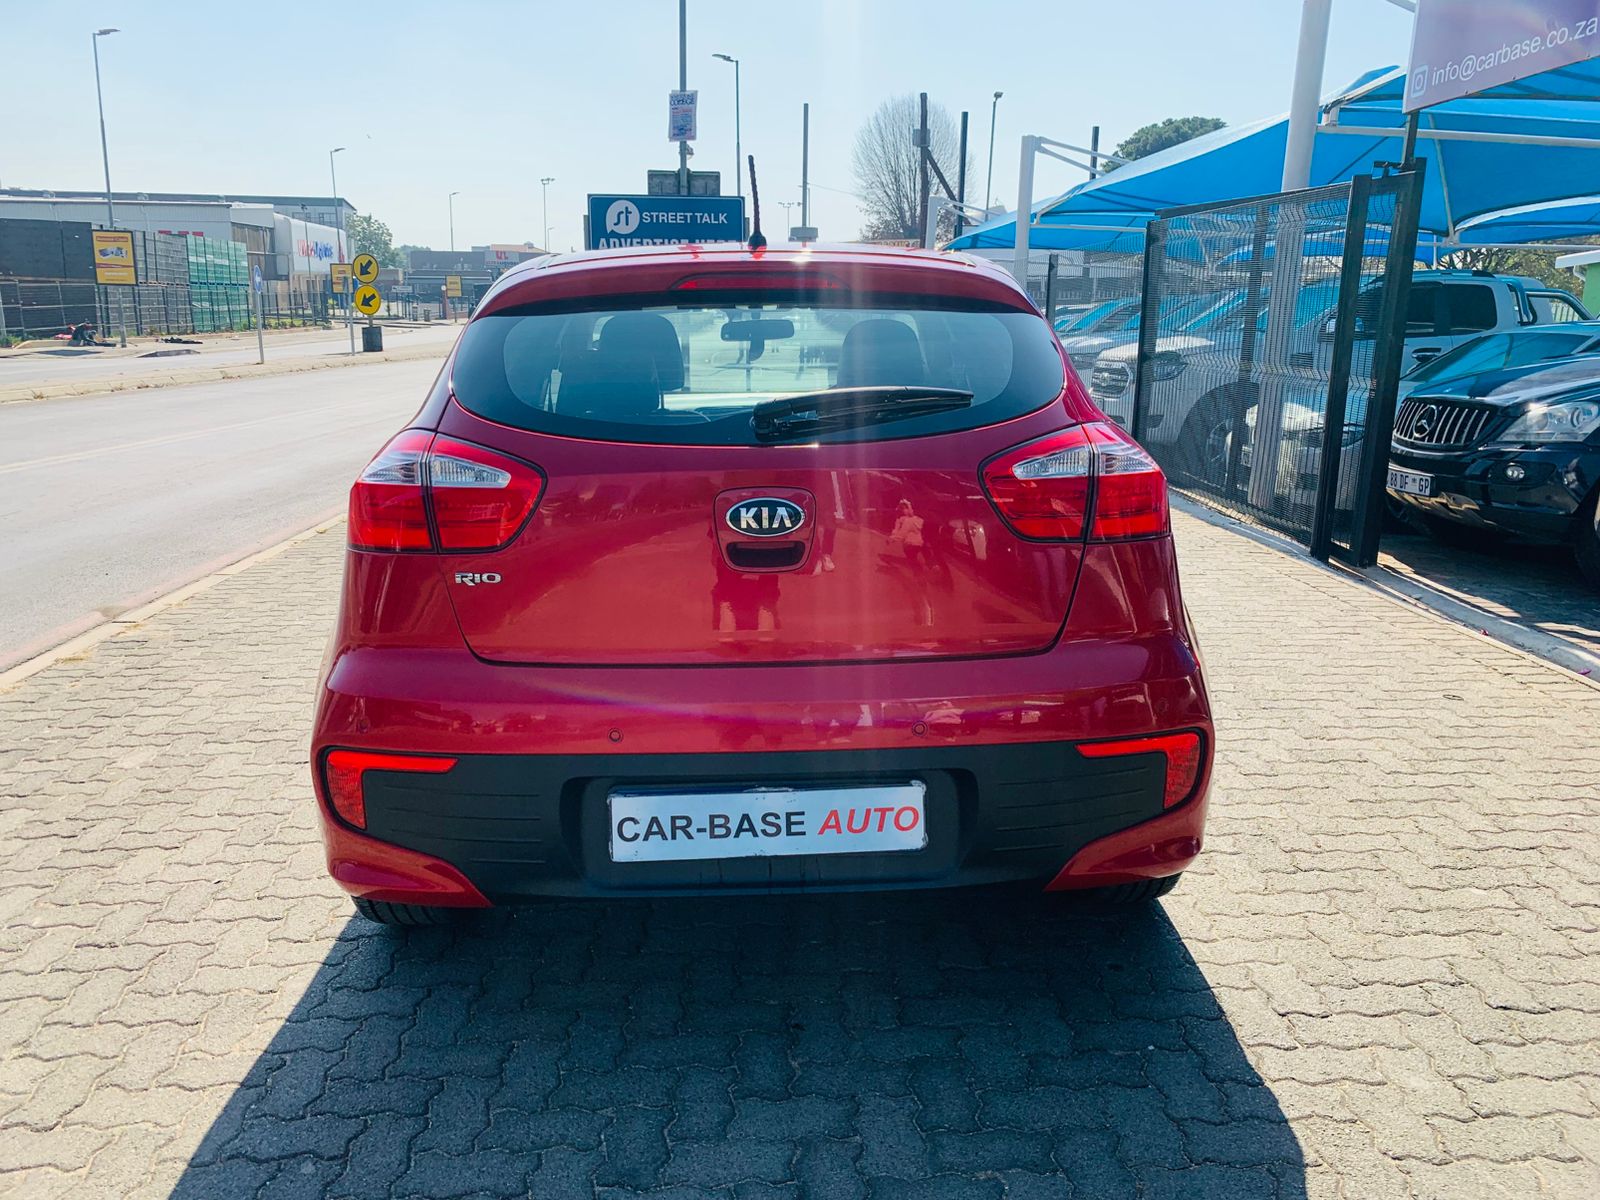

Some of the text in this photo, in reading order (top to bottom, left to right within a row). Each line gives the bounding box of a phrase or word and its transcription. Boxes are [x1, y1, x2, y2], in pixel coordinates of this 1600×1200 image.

[1431, 16, 1599, 87] info@carbase.co.za
[642, 212, 728, 224] STREET TALK
[1418, 477, 1430, 494] GP
[739, 506, 793, 529] KIA
[455, 572, 502, 586] RIO
[616, 806, 920, 842] CAR-BASE AUTO
